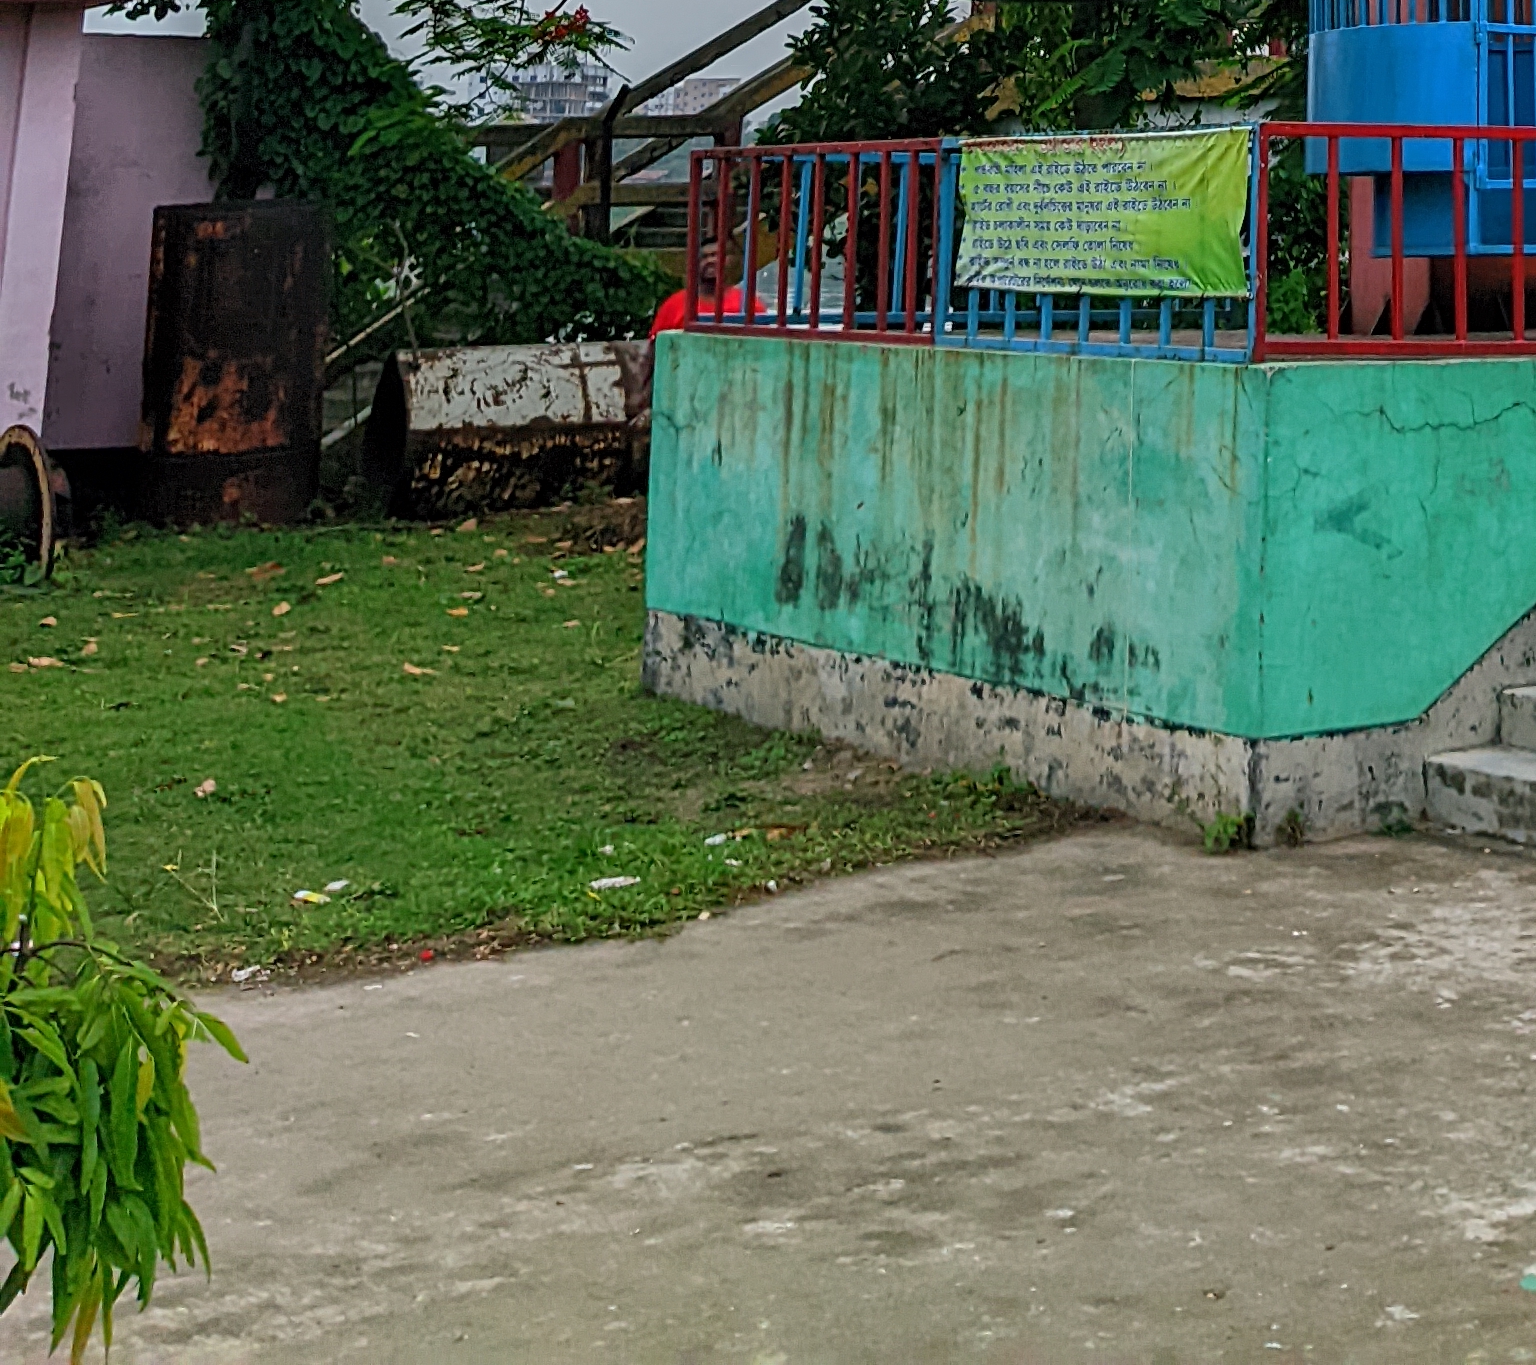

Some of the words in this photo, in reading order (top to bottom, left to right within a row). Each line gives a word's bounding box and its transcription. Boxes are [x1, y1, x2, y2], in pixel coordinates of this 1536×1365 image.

[1030, 162, 1044, 176] এই
[1054, 180, 1073, 194] কেউ
[1077, 179, 1092, 195] এই
[1125, 176, 1154, 192] উঠবেন
[1106, 197, 1119, 212] এই
[1151, 195, 1179, 211] উঠবেন
[1054, 217, 1073, 231] কেউ
